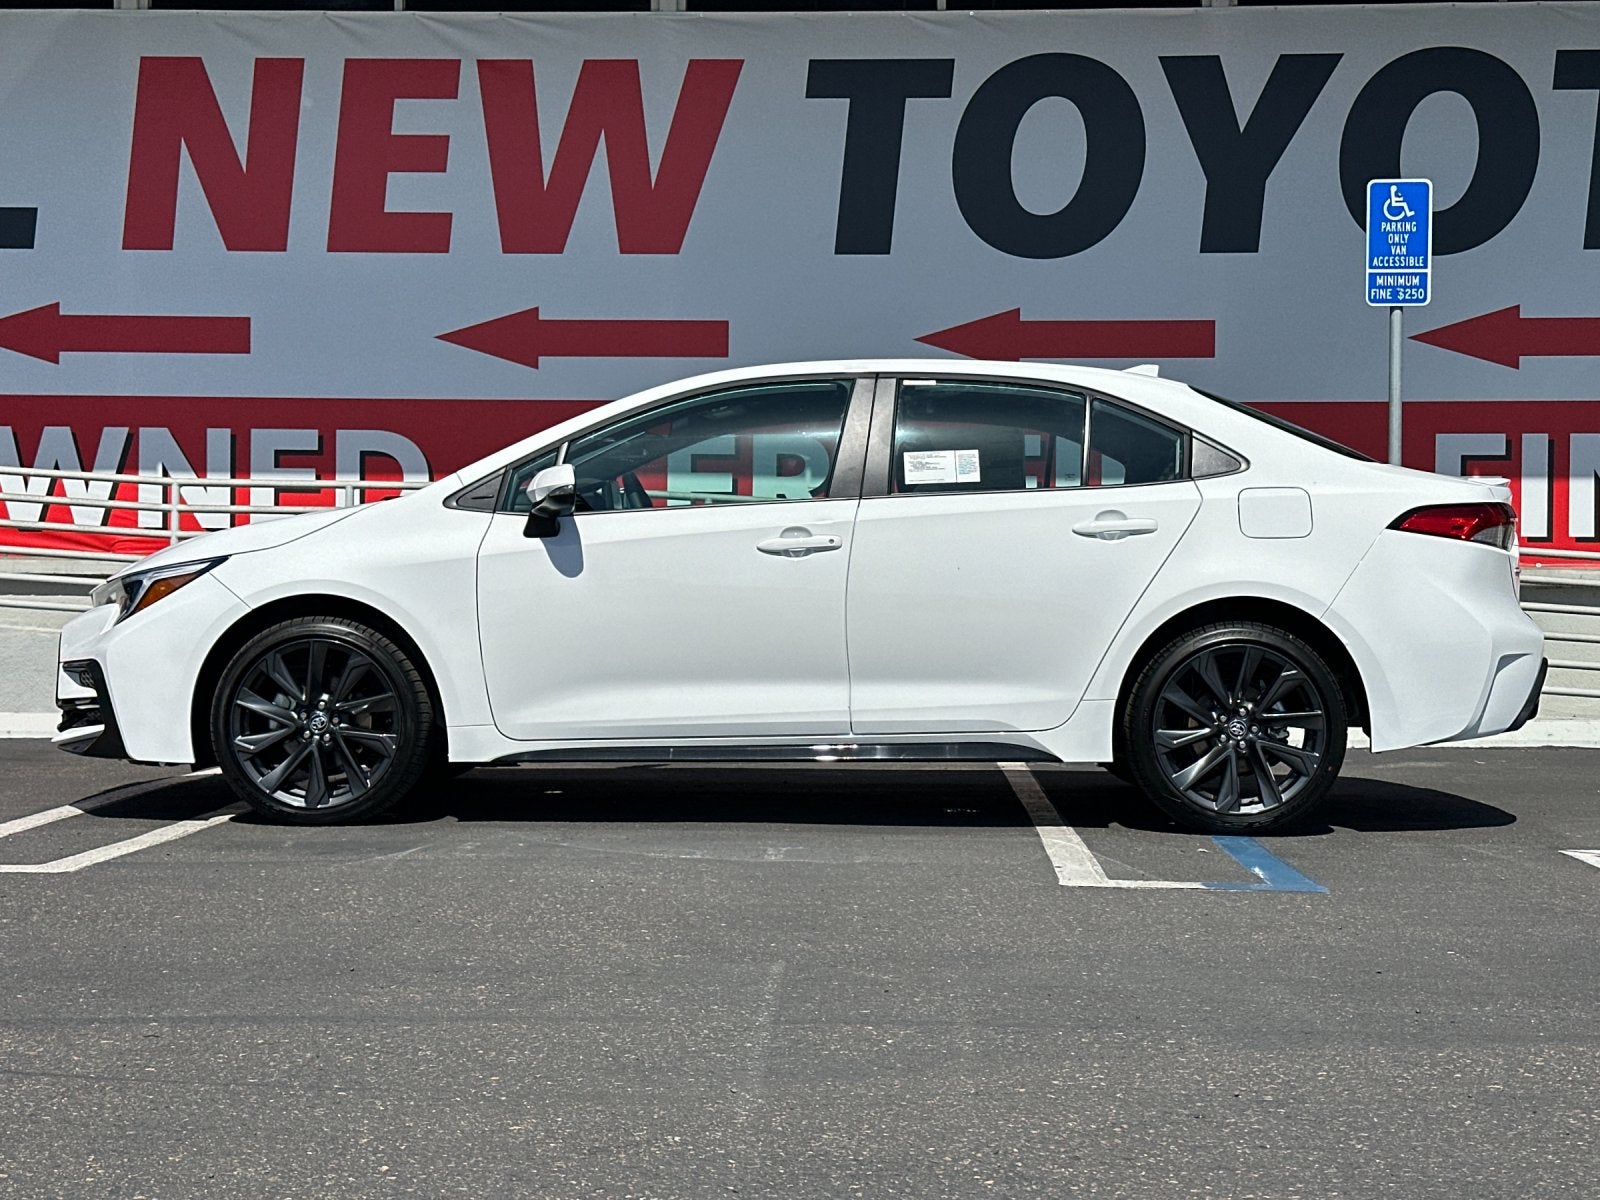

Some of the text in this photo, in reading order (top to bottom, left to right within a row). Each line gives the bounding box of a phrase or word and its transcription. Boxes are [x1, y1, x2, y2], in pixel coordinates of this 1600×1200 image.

[121, 56, 745, 255] NEW
[1381, 221, 1417, 233] PARKING
[1388, 233, 1409, 244] ONLY
[1391, 245, 1407, 256] VAN
[1372, 256, 1425, 267] ACCESSIBLE
[1376, 275, 1420, 287] MINIMUM
[1370, 288, 1425, 301] FINE $250
